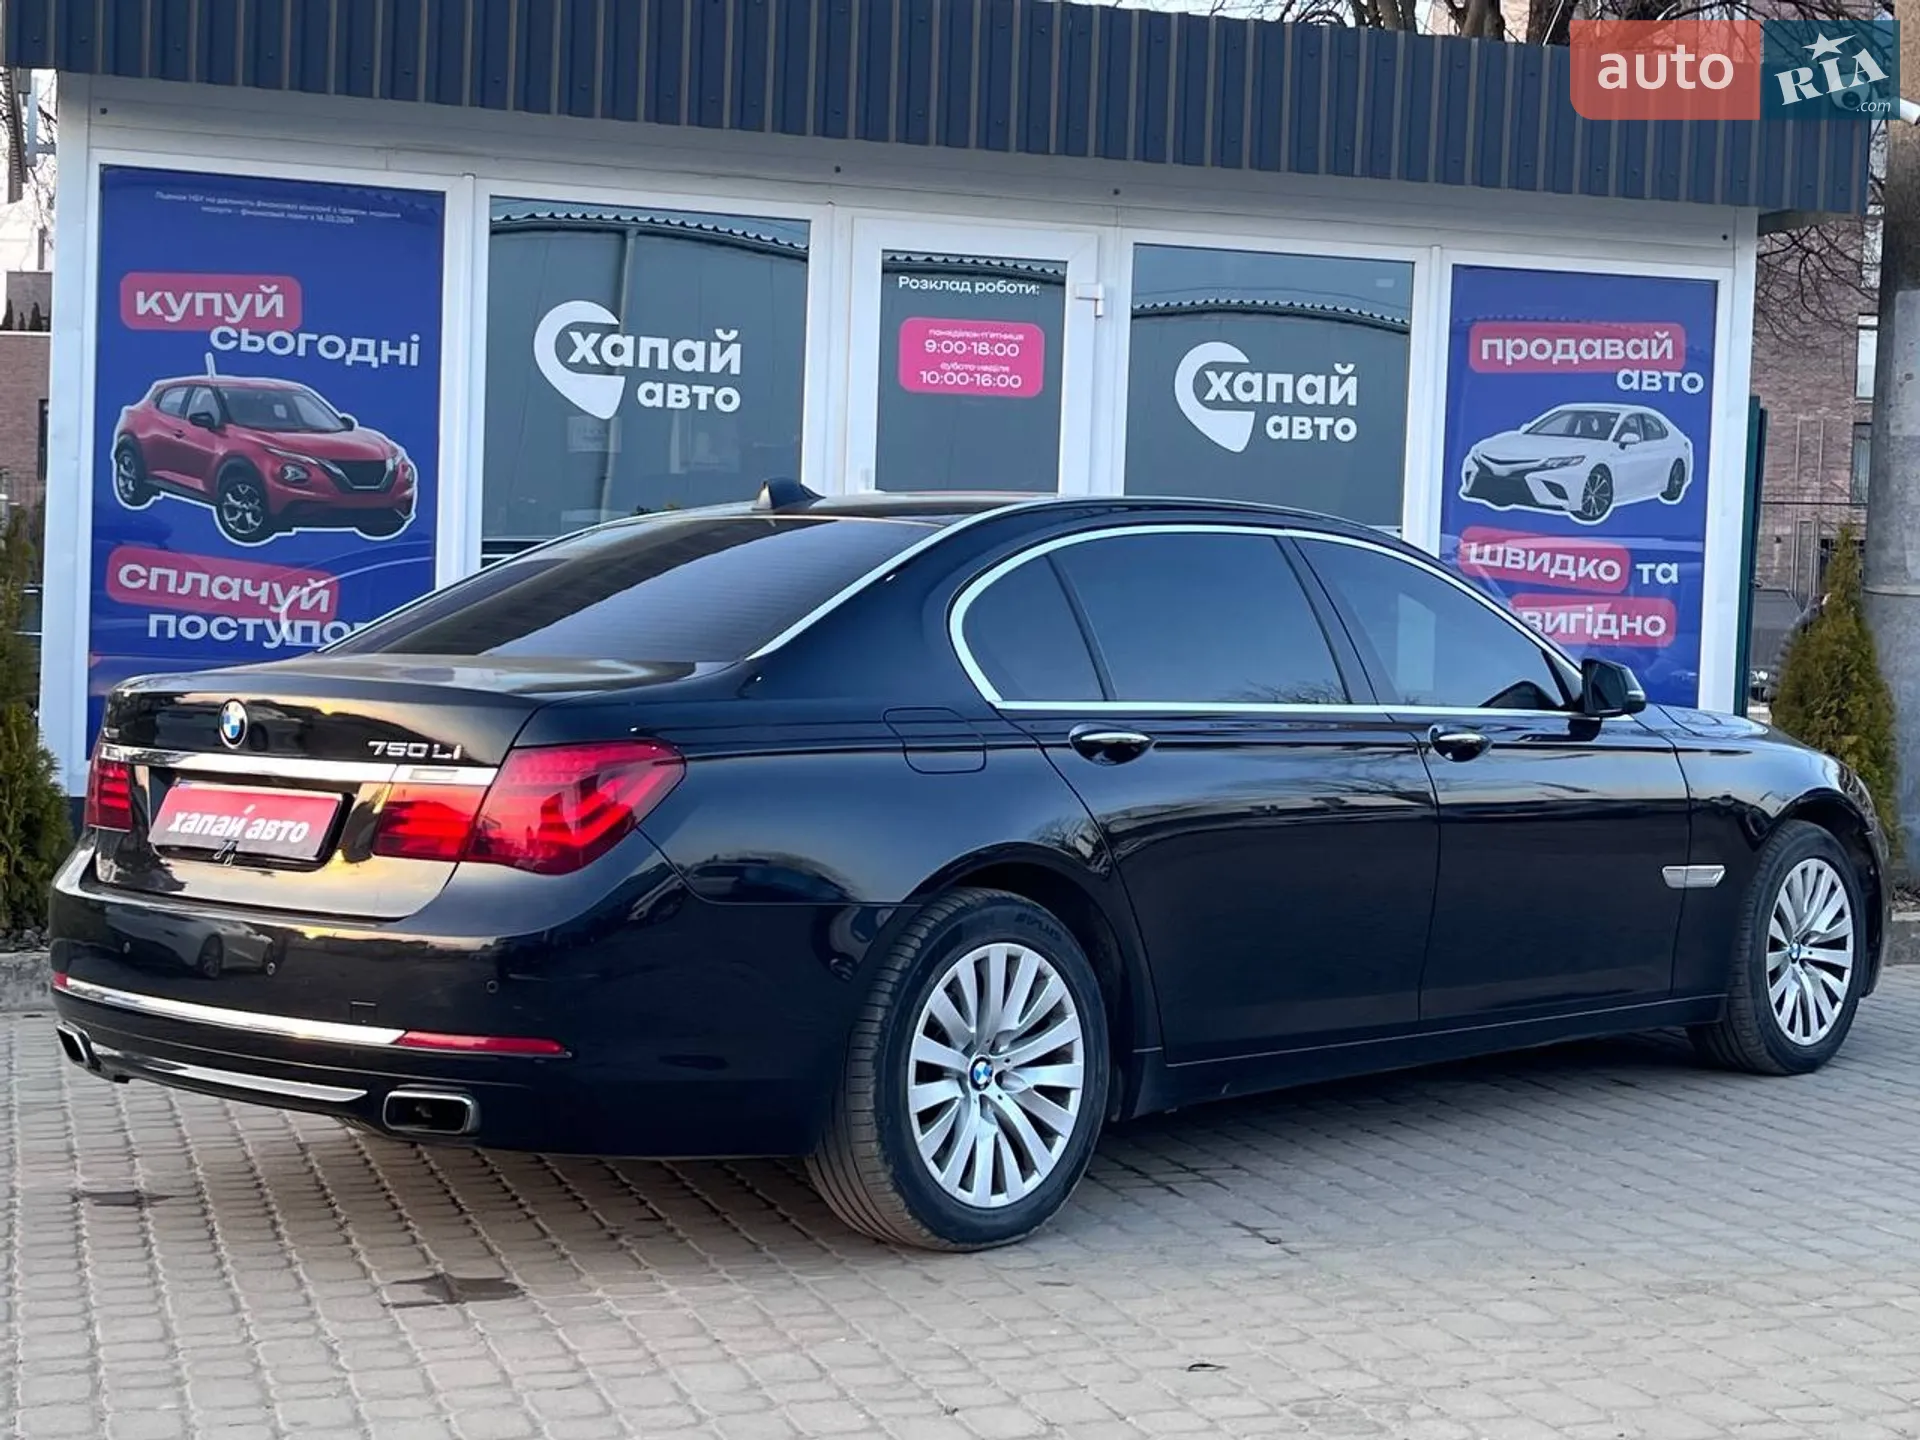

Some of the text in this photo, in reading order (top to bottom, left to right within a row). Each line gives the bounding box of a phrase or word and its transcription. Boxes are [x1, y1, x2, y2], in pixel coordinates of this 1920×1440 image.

[899, 276, 1040, 295] Розклад роботи:
[136, 284, 284, 324] купуй
[209, 326, 420, 368] сьогодні
[567, 328, 742, 375] хапай
[924, 339, 1020, 357] 9:00-18:00
[1481, 330, 1673, 365] продавай
[919, 370, 1022, 389] 10:00-16:00
[1203, 363, 1358, 406] хапай
[1616, 368, 1704, 394] авто
[637, 380, 741, 413] авто
[1265, 414, 1358, 442] авто
[1468, 542, 1679, 585] швидко та
[118, 563, 330, 613] сплачуй
[1522, 606, 1667, 639] вигідно
[368, 740, 429, 758] 750
[245, 817, 310, 843] авто
